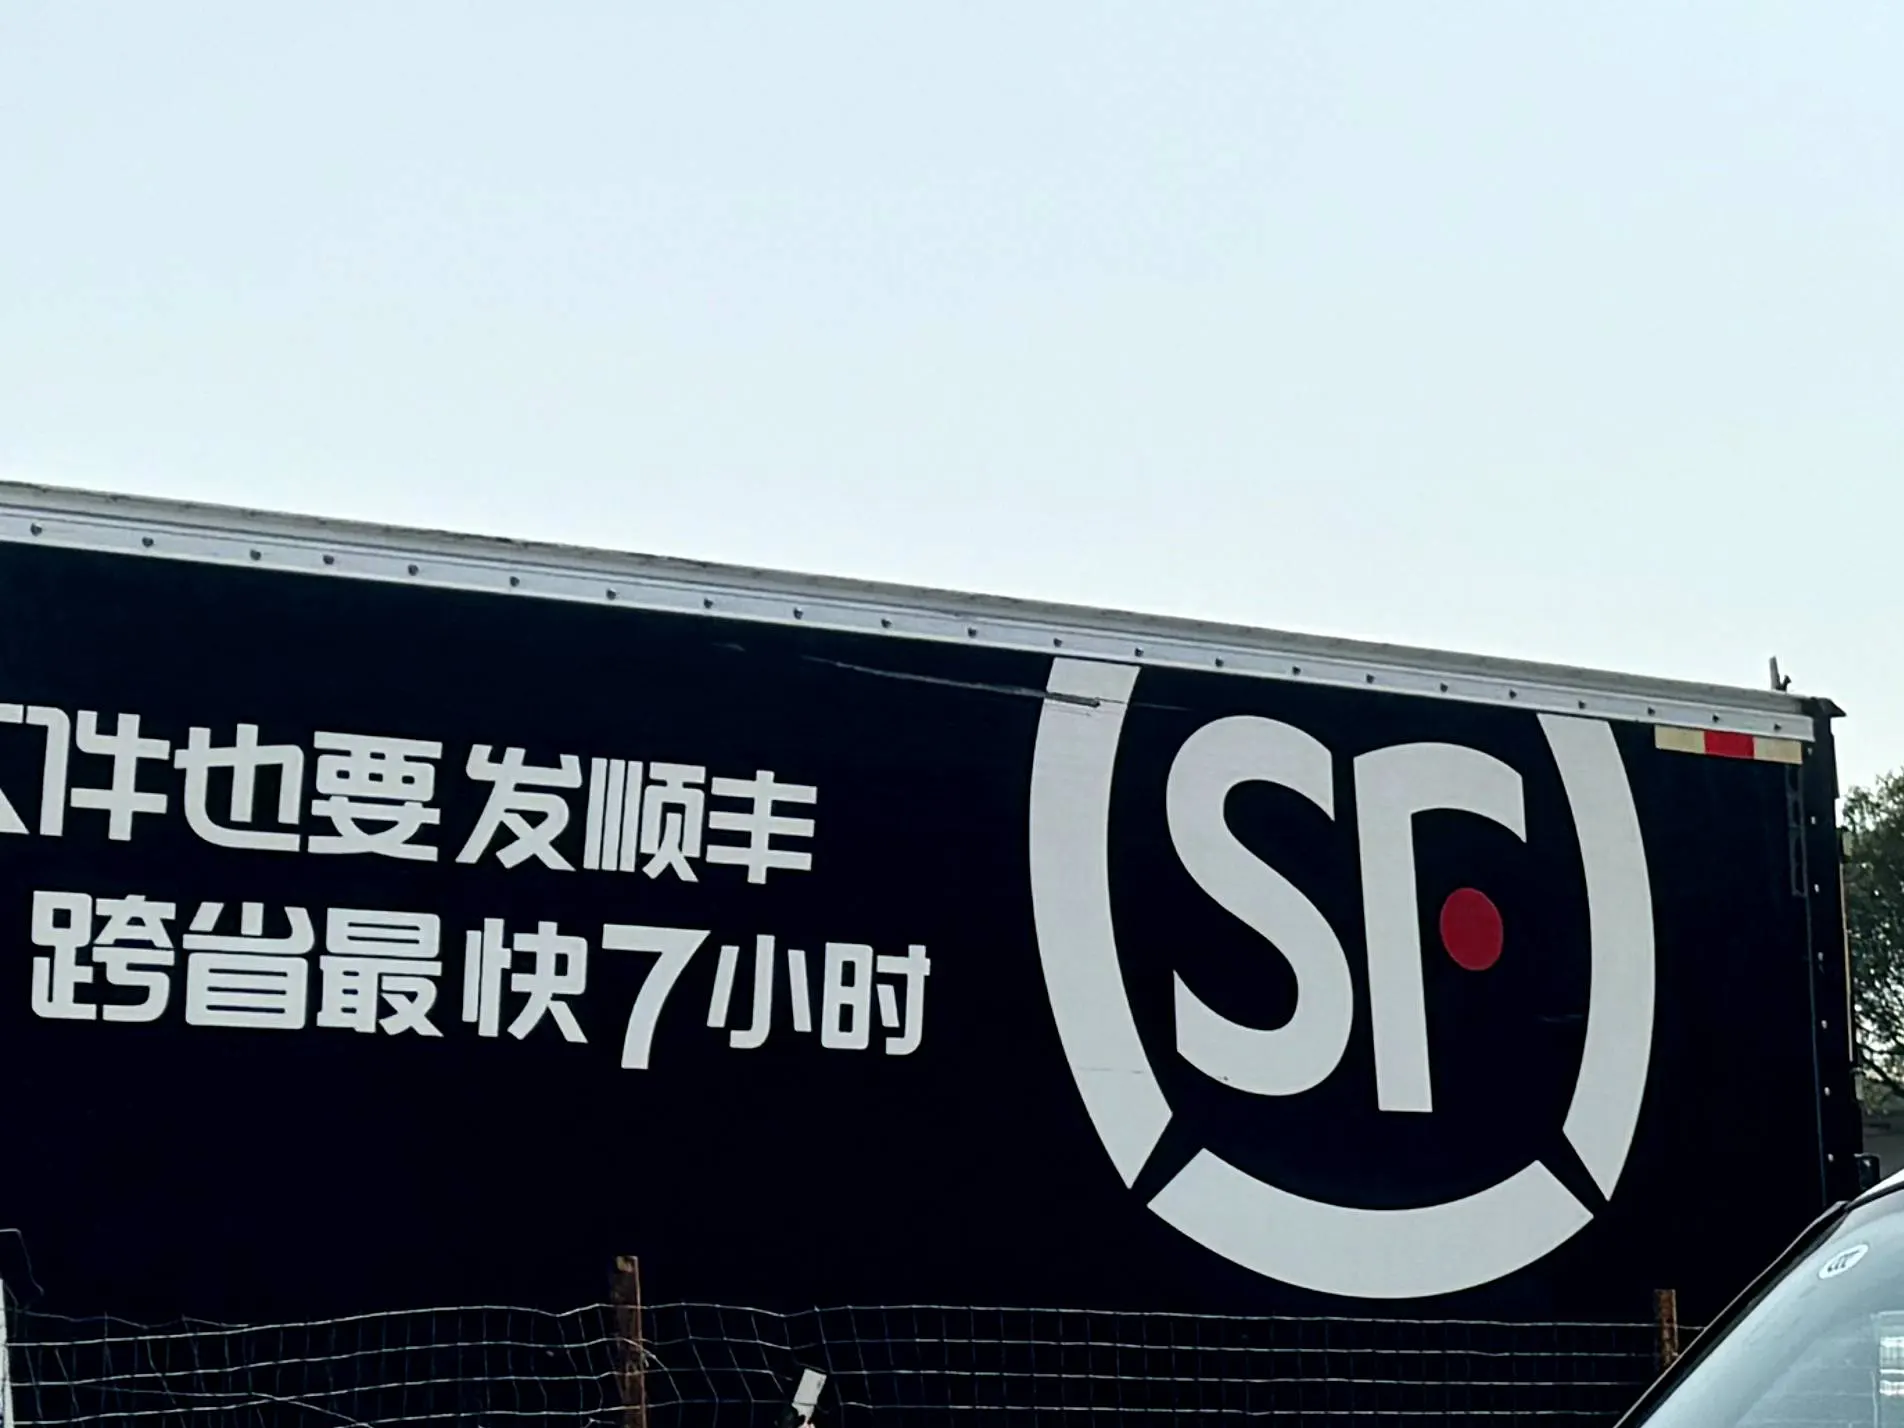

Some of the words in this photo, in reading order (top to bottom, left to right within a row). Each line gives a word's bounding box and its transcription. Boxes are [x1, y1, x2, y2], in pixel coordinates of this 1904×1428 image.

[30, 890, 932, 1071] 跨省最快7小时
